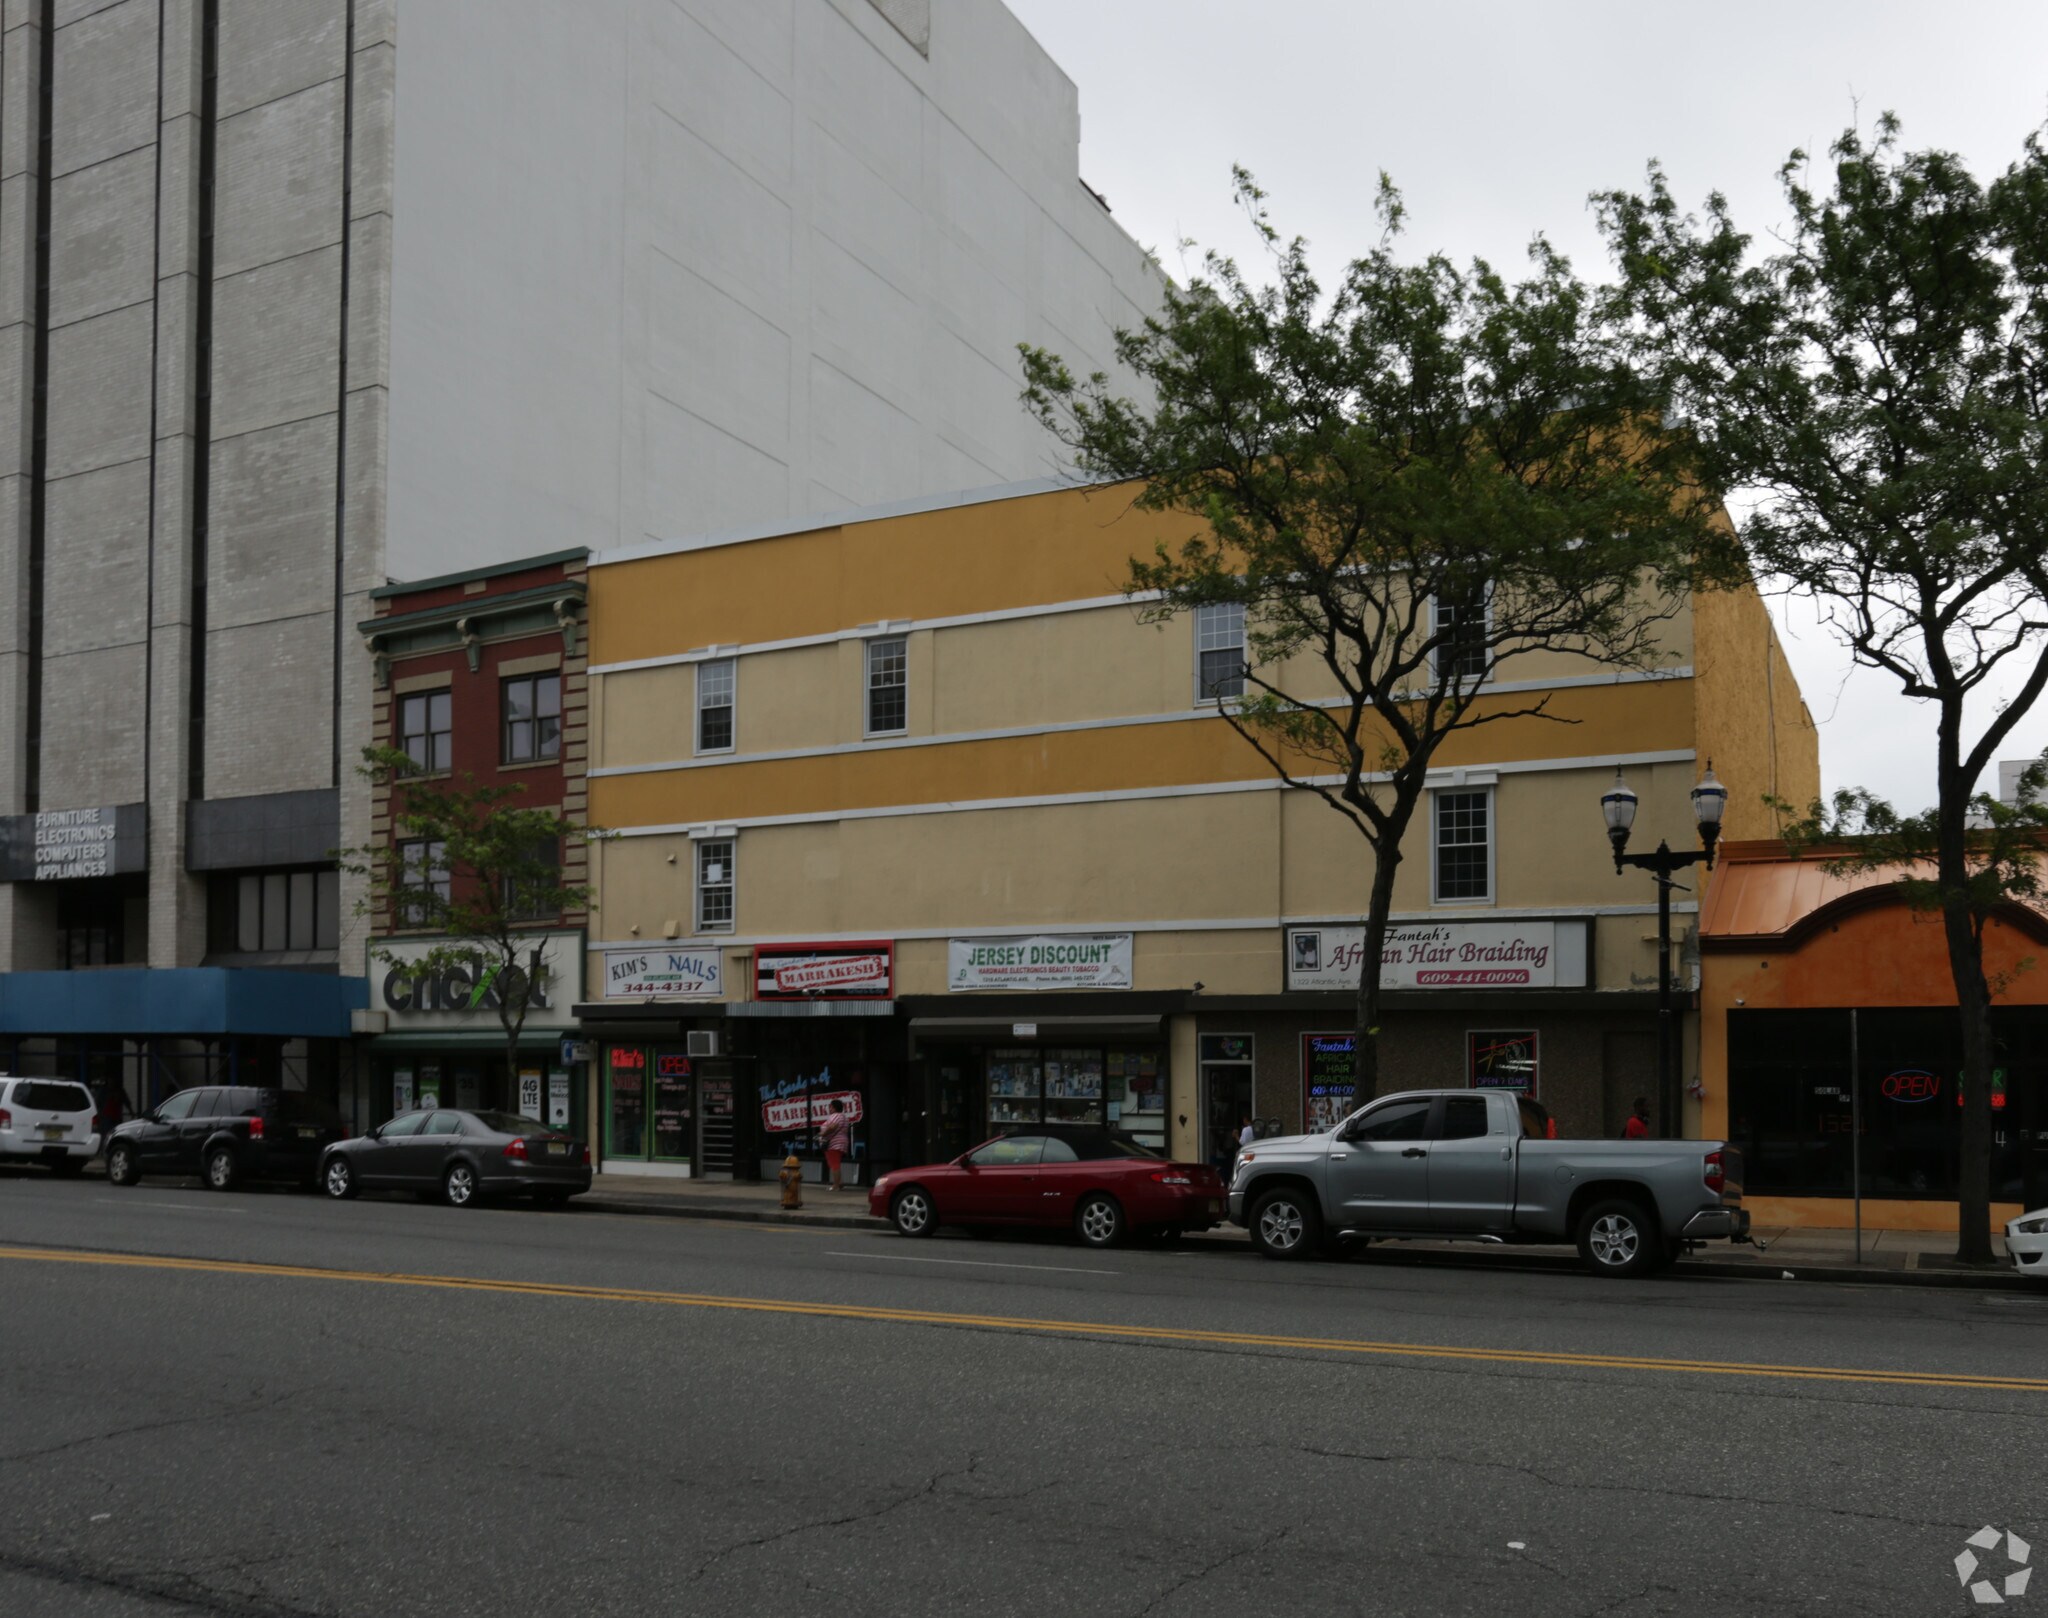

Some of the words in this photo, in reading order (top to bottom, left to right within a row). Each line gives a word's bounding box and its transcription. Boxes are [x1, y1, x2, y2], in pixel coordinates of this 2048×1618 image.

[36, 809, 100, 828] FURNITURE
[35, 825, 116, 845] ELECTRONICS
[35, 843, 106, 864] COMPUTERS
[35, 861, 106, 881] APPLIANCES
[1384, 927, 1450, 946] Fantah's
[968, 946, 1026, 966] JERSEY
[1030, 944, 1112, 964] DISCOUNT
[1326, 943, 1402, 972] Afran
[1407, 942, 1456, 964] Hair
[1459, 939, 1549, 968] Braiding
[611, 956, 648, 981] KIM'S
[668, 955, 718, 981] NAILS
[784, 962, 875, 985] MARRAKESH
[978, 966, 1009, 975] HARDWARE
[1010, 965, 1048, 974] ELECTRONICS
[1049, 965, 1071, 973] BEAUTY
[1072, 964, 1100, 973] TOBACCO
[1421, 971, 1526, 984] 609-441-0096
[383, 950, 549, 1011] cricket
[622, 981, 704, 993] 344-4337
[1310, 977, 1337, 985] Atlantic
[1383, 977, 1398, 987] City
[1311, 1038, 1357, 1052] Fantah'
[1327, 1064, 1350, 1074] HAIR
[522, 1080, 538, 1092] 4G
[1476, 1077, 1499, 1086] OPEN
[1508, 1076, 1529, 1086] DAYS
[1880, 1076, 1942, 1098] OPEN
[522, 1093, 538, 1105] LTE
[772, 1101, 854, 1123] MARRAKH
